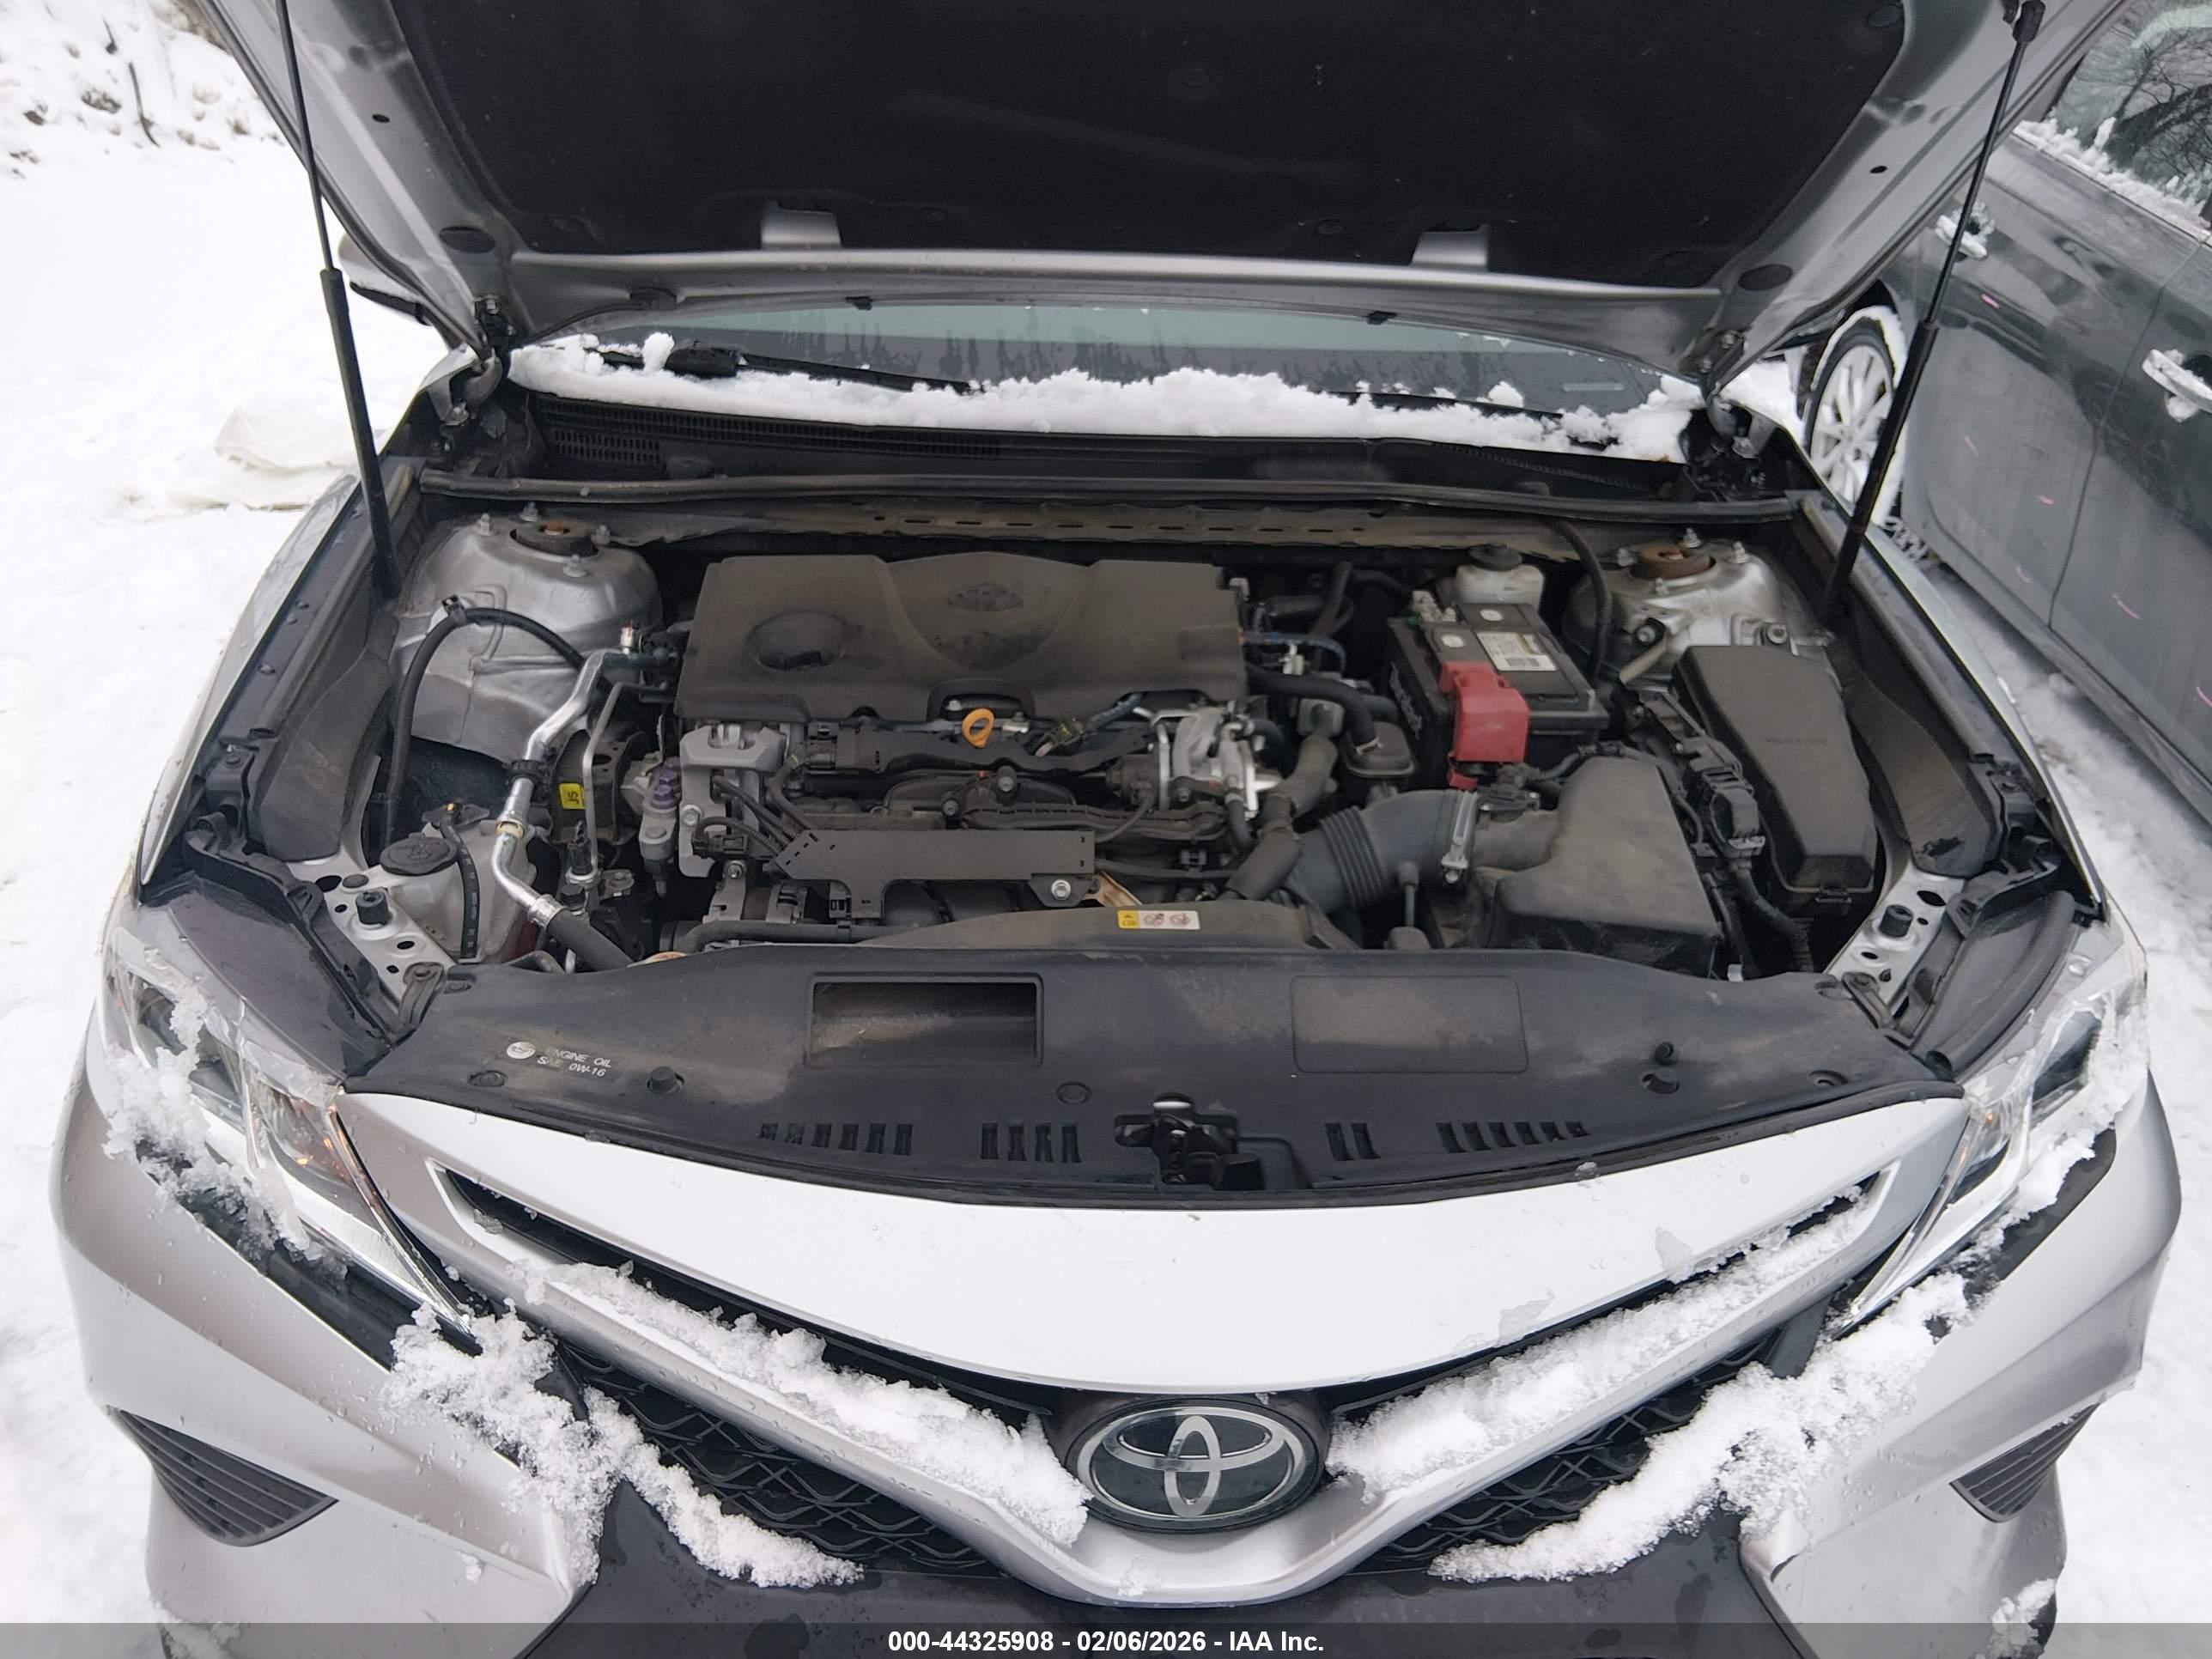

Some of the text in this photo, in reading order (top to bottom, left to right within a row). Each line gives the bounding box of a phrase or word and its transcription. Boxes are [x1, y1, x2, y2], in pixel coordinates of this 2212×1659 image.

[546, 1047, 612, 1068] ENGINE OIL
[568, 1062, 606, 1078] 0W-16
